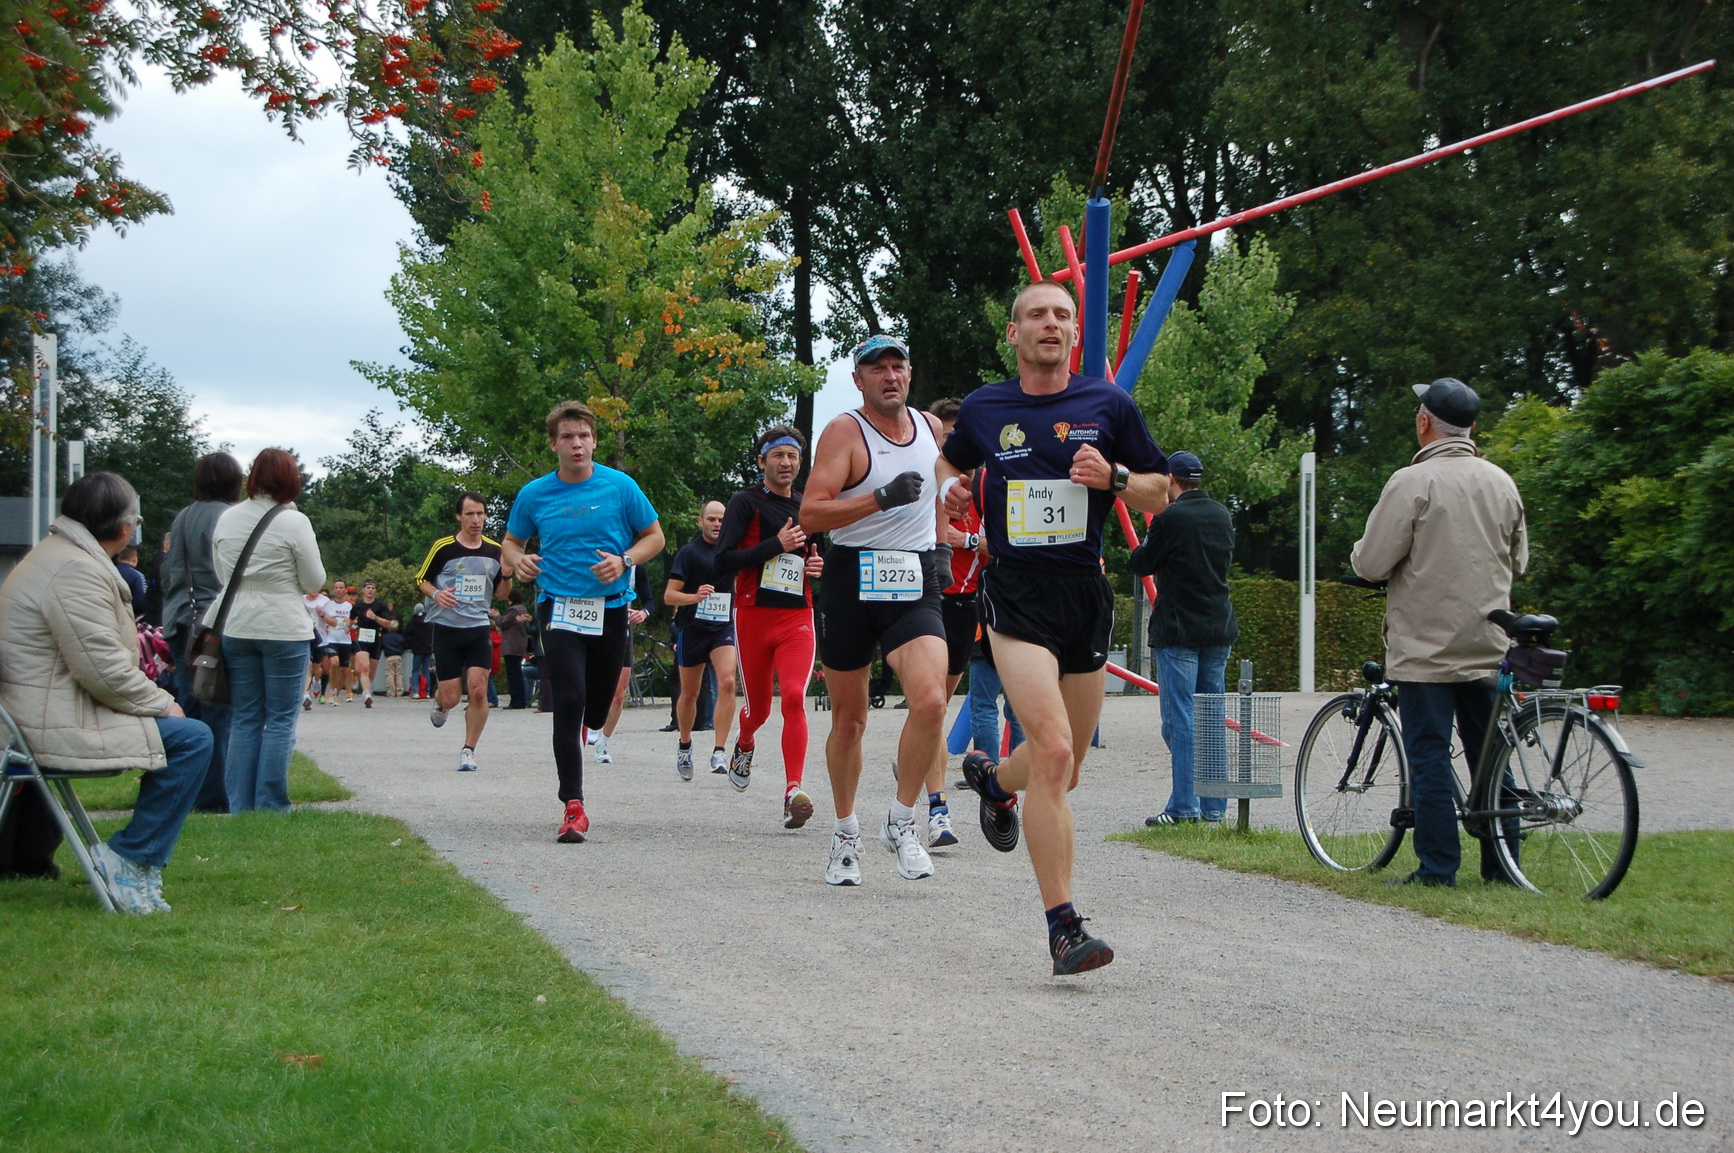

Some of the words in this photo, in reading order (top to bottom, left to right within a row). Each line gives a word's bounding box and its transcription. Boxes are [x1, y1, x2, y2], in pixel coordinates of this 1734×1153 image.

[1028, 486, 1053, 501] Andy
[1010, 506, 1015, 515] A
[1043, 506, 1065, 524] 31
[778, 555, 794, 565] Franz
[877, 555, 905, 564] Michael
[781, 568, 799, 582] 782
[879, 569, 916, 582] 3273
[464, 584, 482, 592] 2895
[569, 597, 595, 606] Andreas
[707, 602, 726, 611] 3318
[568, 608, 598, 622] 3429
